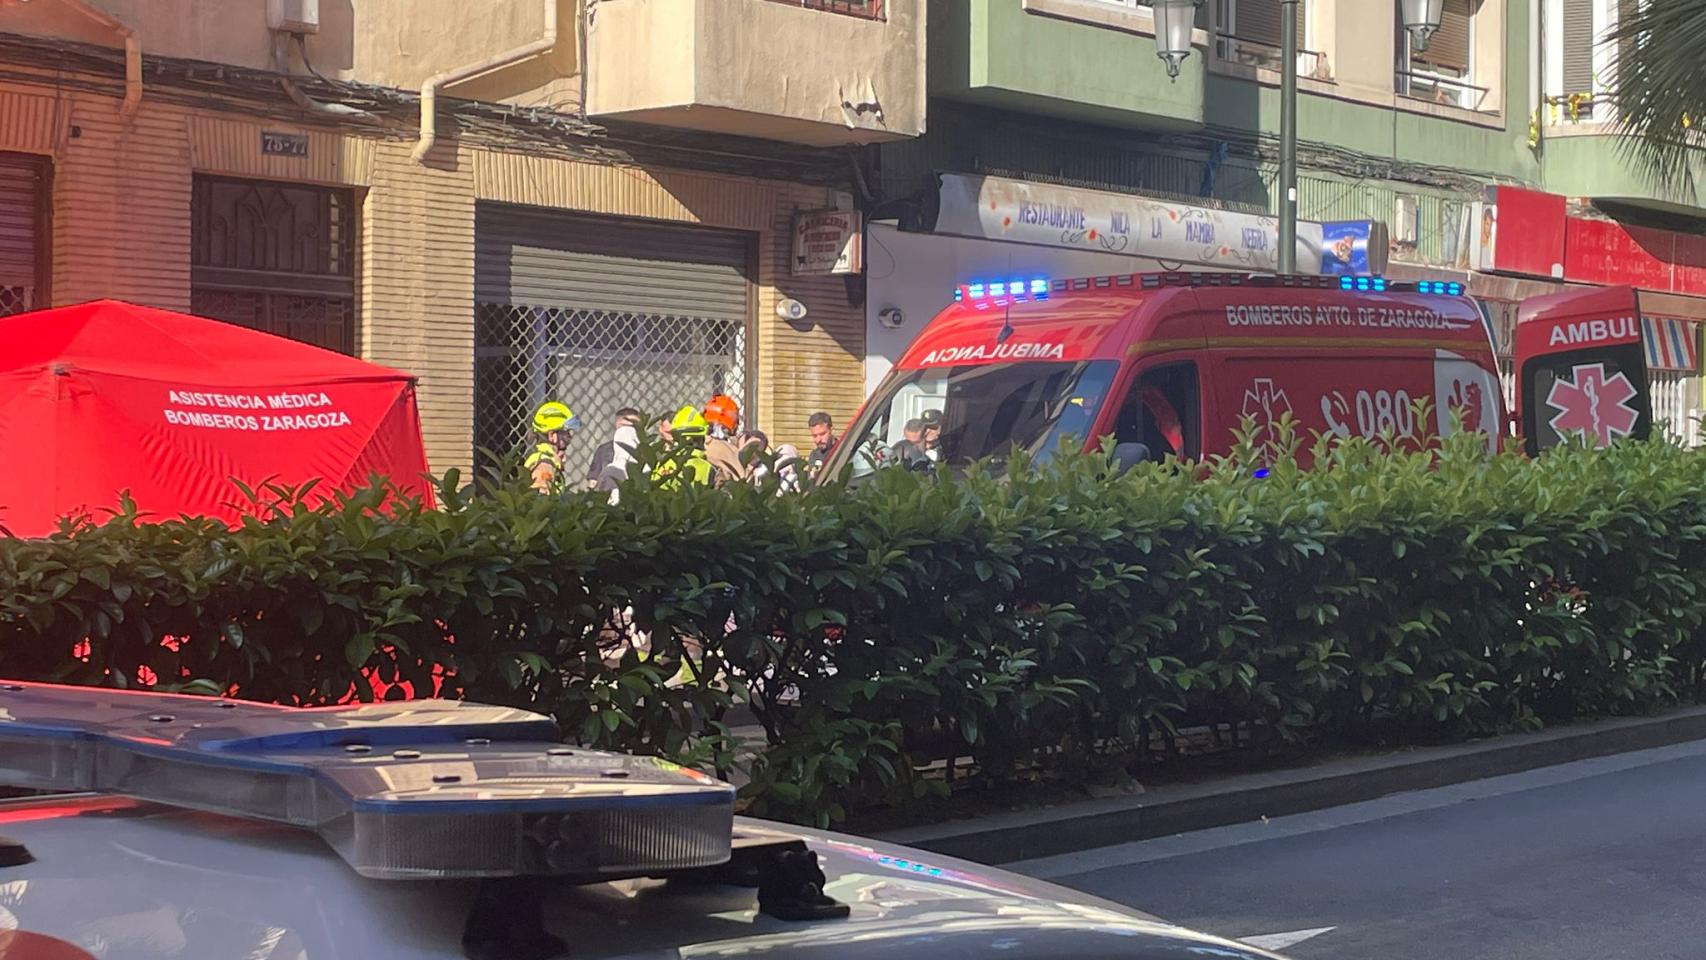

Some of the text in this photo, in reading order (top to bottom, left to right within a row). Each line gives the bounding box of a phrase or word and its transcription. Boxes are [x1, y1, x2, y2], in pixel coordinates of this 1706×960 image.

[1018, 201, 1086, 230] RESTAURANTE
[1151, 217, 1163, 239] LA
[1185, 220, 1216, 244] MAMBA
[1241, 227, 1269, 250] NEGRA
[1226, 305, 1451, 329] BOMBEROS AYTO. DE ZARAGOZA
[168, 390, 332, 410] ASISTENCIA MÉDICA
[163, 409, 352, 431] BOMBEROS ZARAGOZA
[1355, 389, 1414, 440] 080
